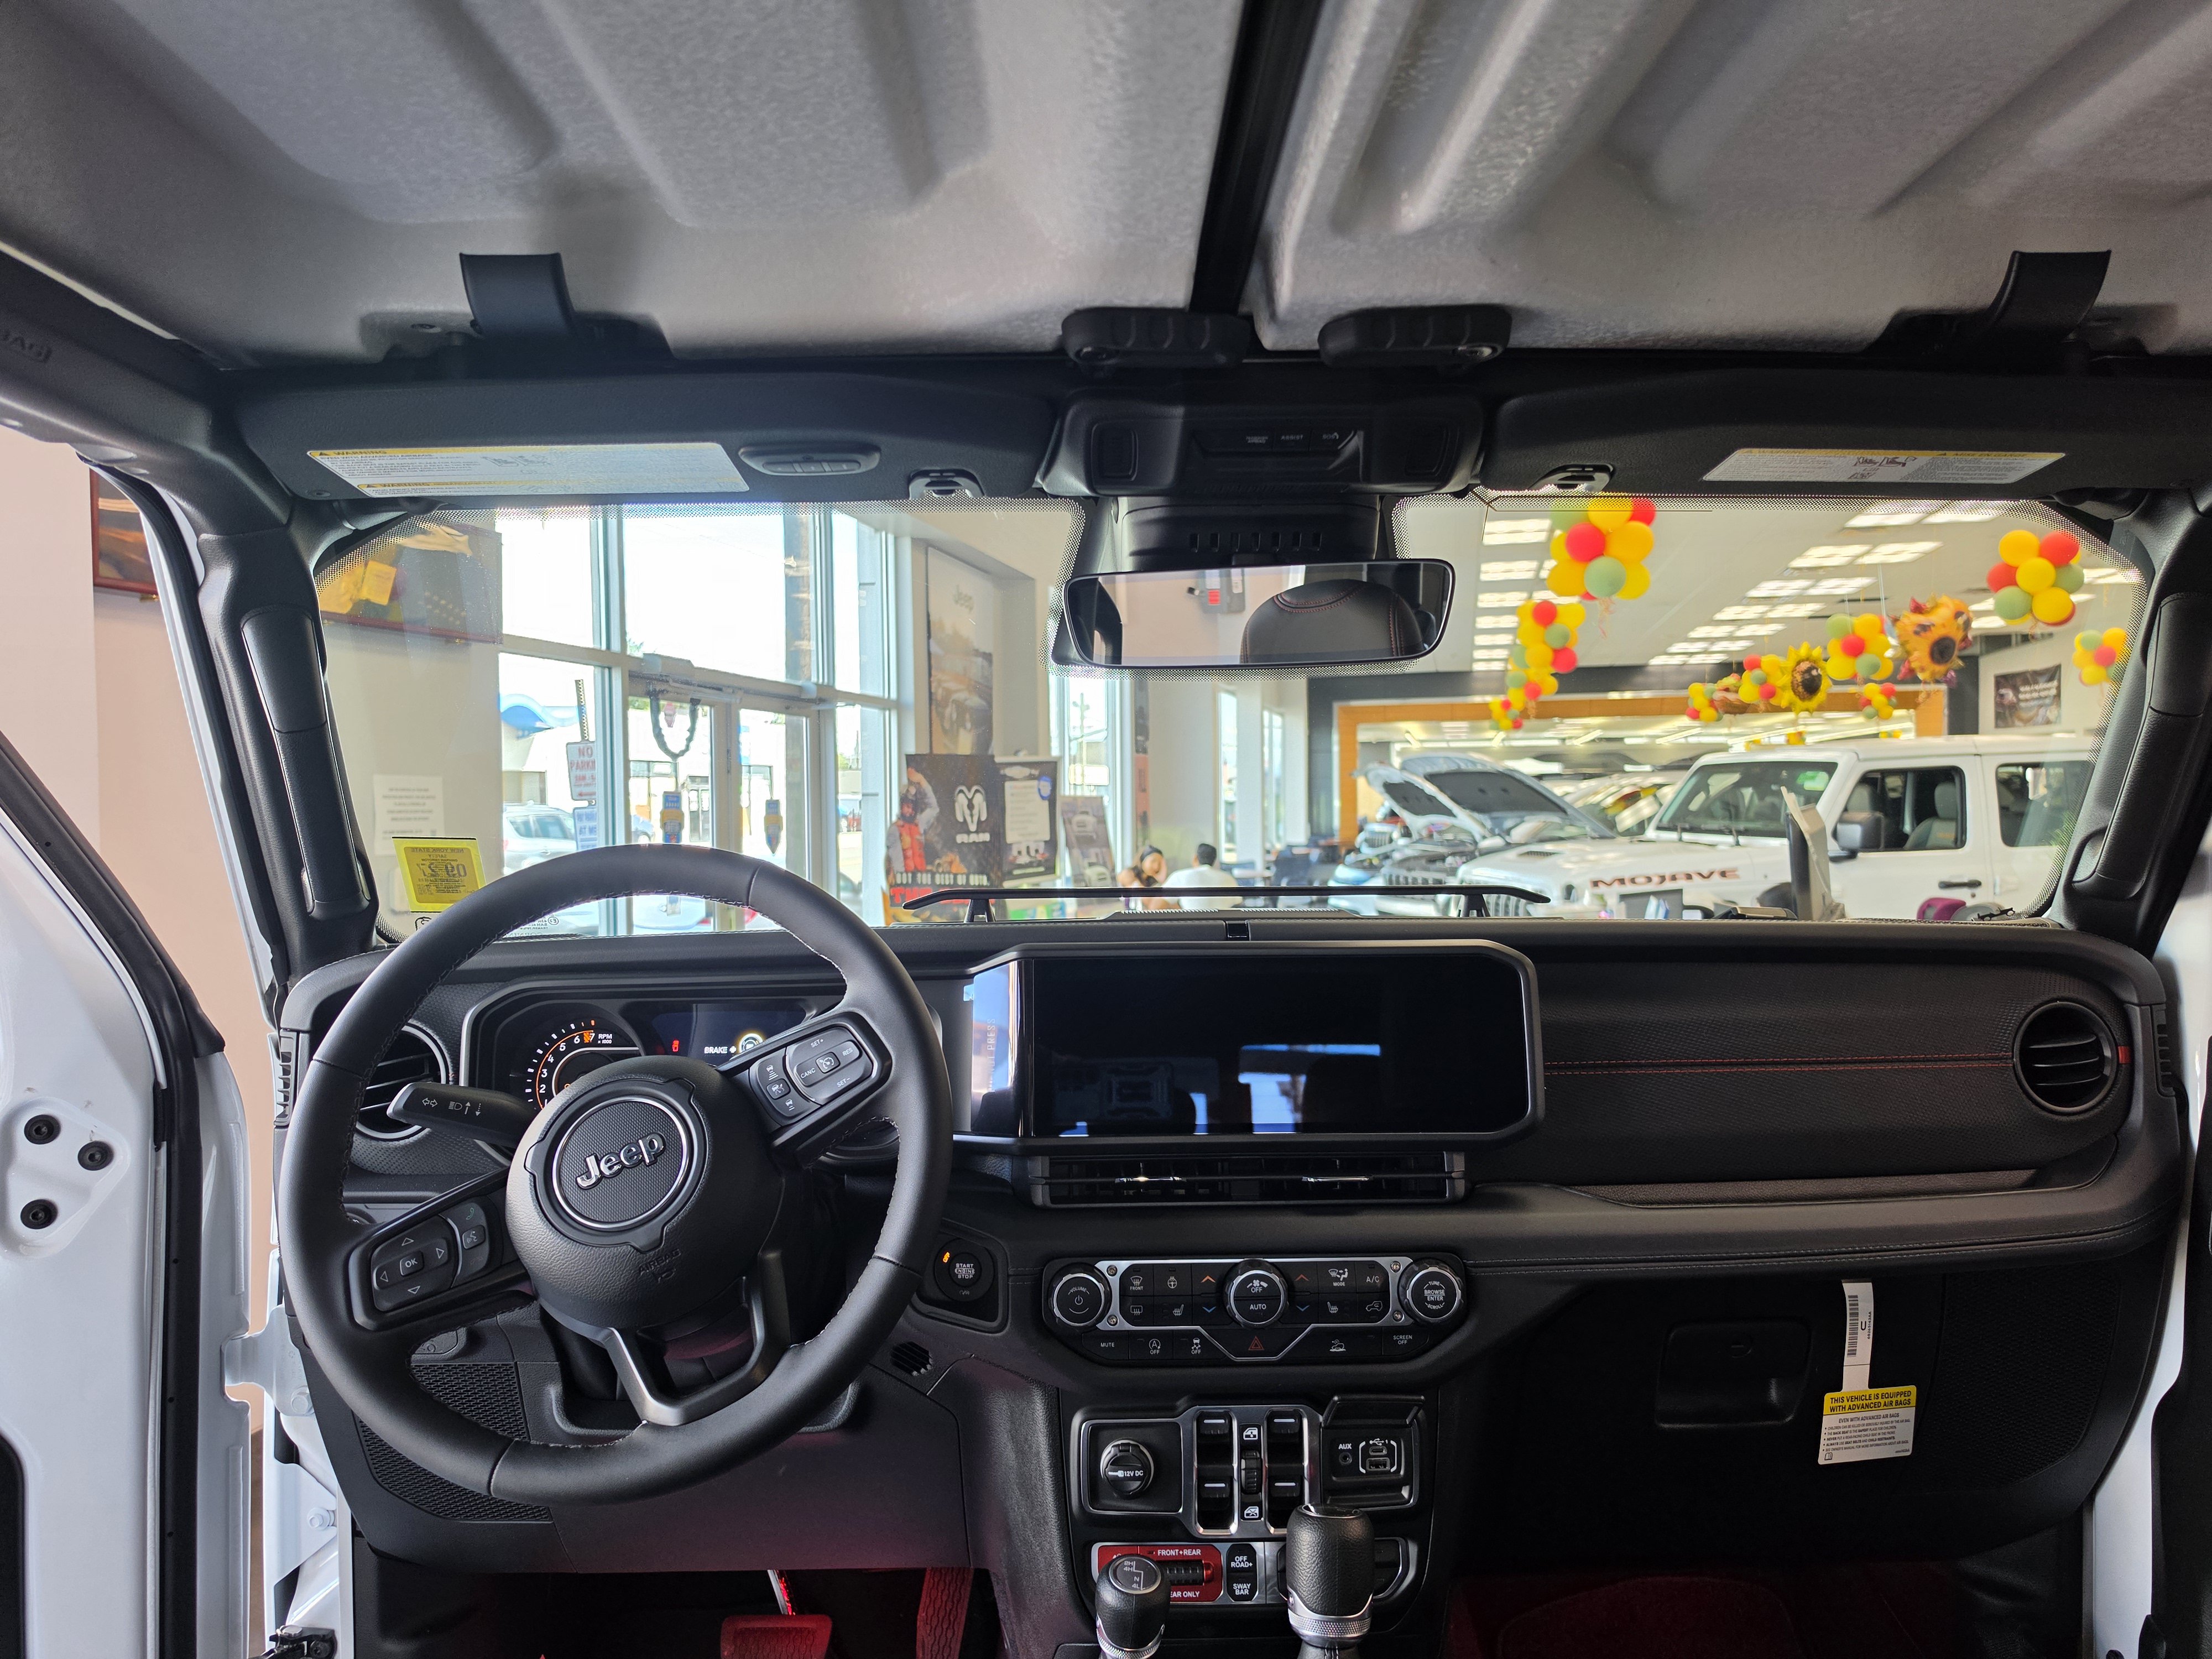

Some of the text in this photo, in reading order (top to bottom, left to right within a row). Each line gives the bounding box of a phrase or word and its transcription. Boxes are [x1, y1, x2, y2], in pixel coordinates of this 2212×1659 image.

[578, 747, 593, 758] NO
[956, 833, 990, 843] RAM
[1590, 868, 1741, 888] MOJAVE
[589, 1032, 596, 1042] 7
[987, 1018, 995, 1050] PRESS
[573, 1035, 581, 1044] 6
[810, 1039, 823, 1048] SET+
[559, 1042, 566, 1051] 5
[842, 1047, 853, 1056] RES
[547, 1054, 554, 1063] 4
[541, 1068, 548, 1078] 3
[800, 1067, 816, 1079] CANC
[539, 1084, 546, 1093] 2
[576, 1132, 666, 1190] Jeep
[405, 1257, 418, 1268] OK
[638, 1249, 681, 1276] AIRBAG
[1846, 1394, 1872, 1402] VEHICLE
[1881, 1390, 1911, 1399] EQUIPPED
[1848, 1401, 1881, 1411] ADVANCED
[1157, 1548, 1201, 1557] FRONT+REAR
